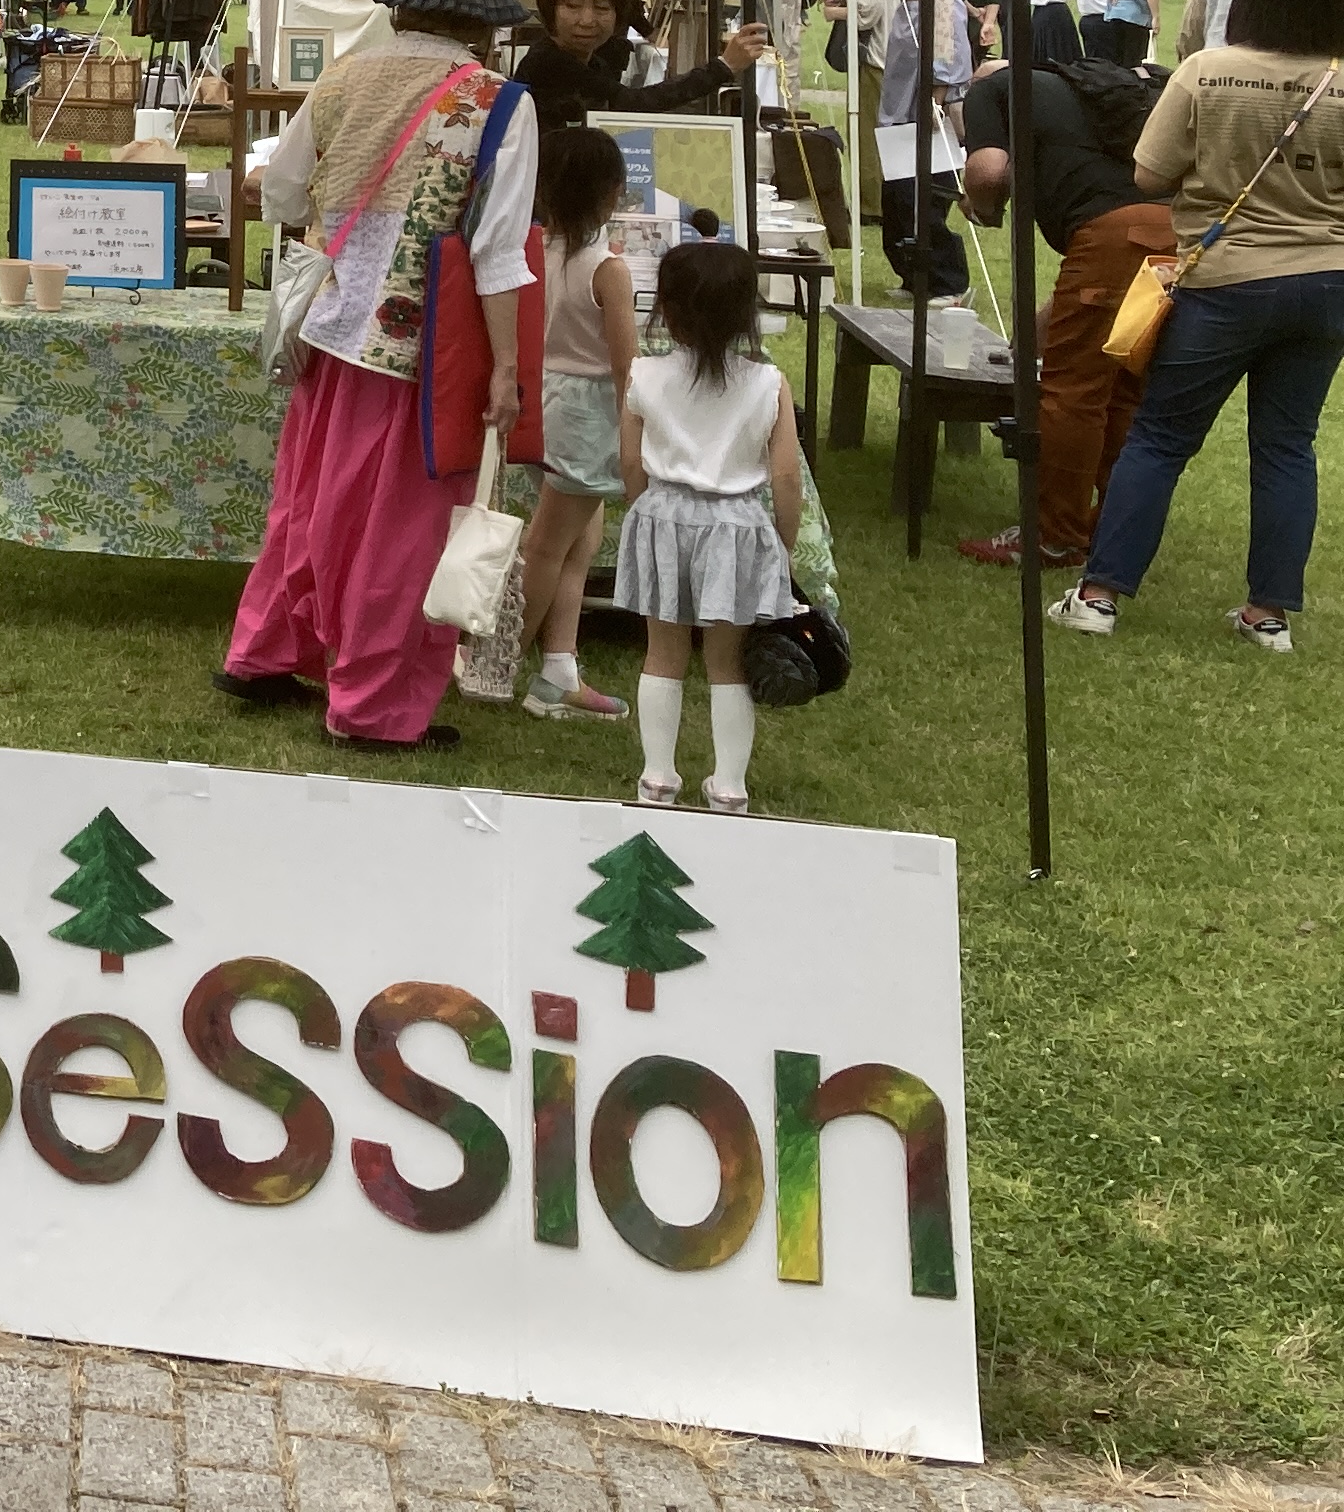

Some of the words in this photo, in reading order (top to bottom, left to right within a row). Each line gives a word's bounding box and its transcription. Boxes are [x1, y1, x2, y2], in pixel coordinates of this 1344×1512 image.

[1198, 76, 1279, 92] California,
[1283, 81, 1315, 94] Sinc
[627, 163, 650, 172] リウム
[625, 174, 653, 184] ショップ
[58, 205, 126, 221] 絵付け教室
